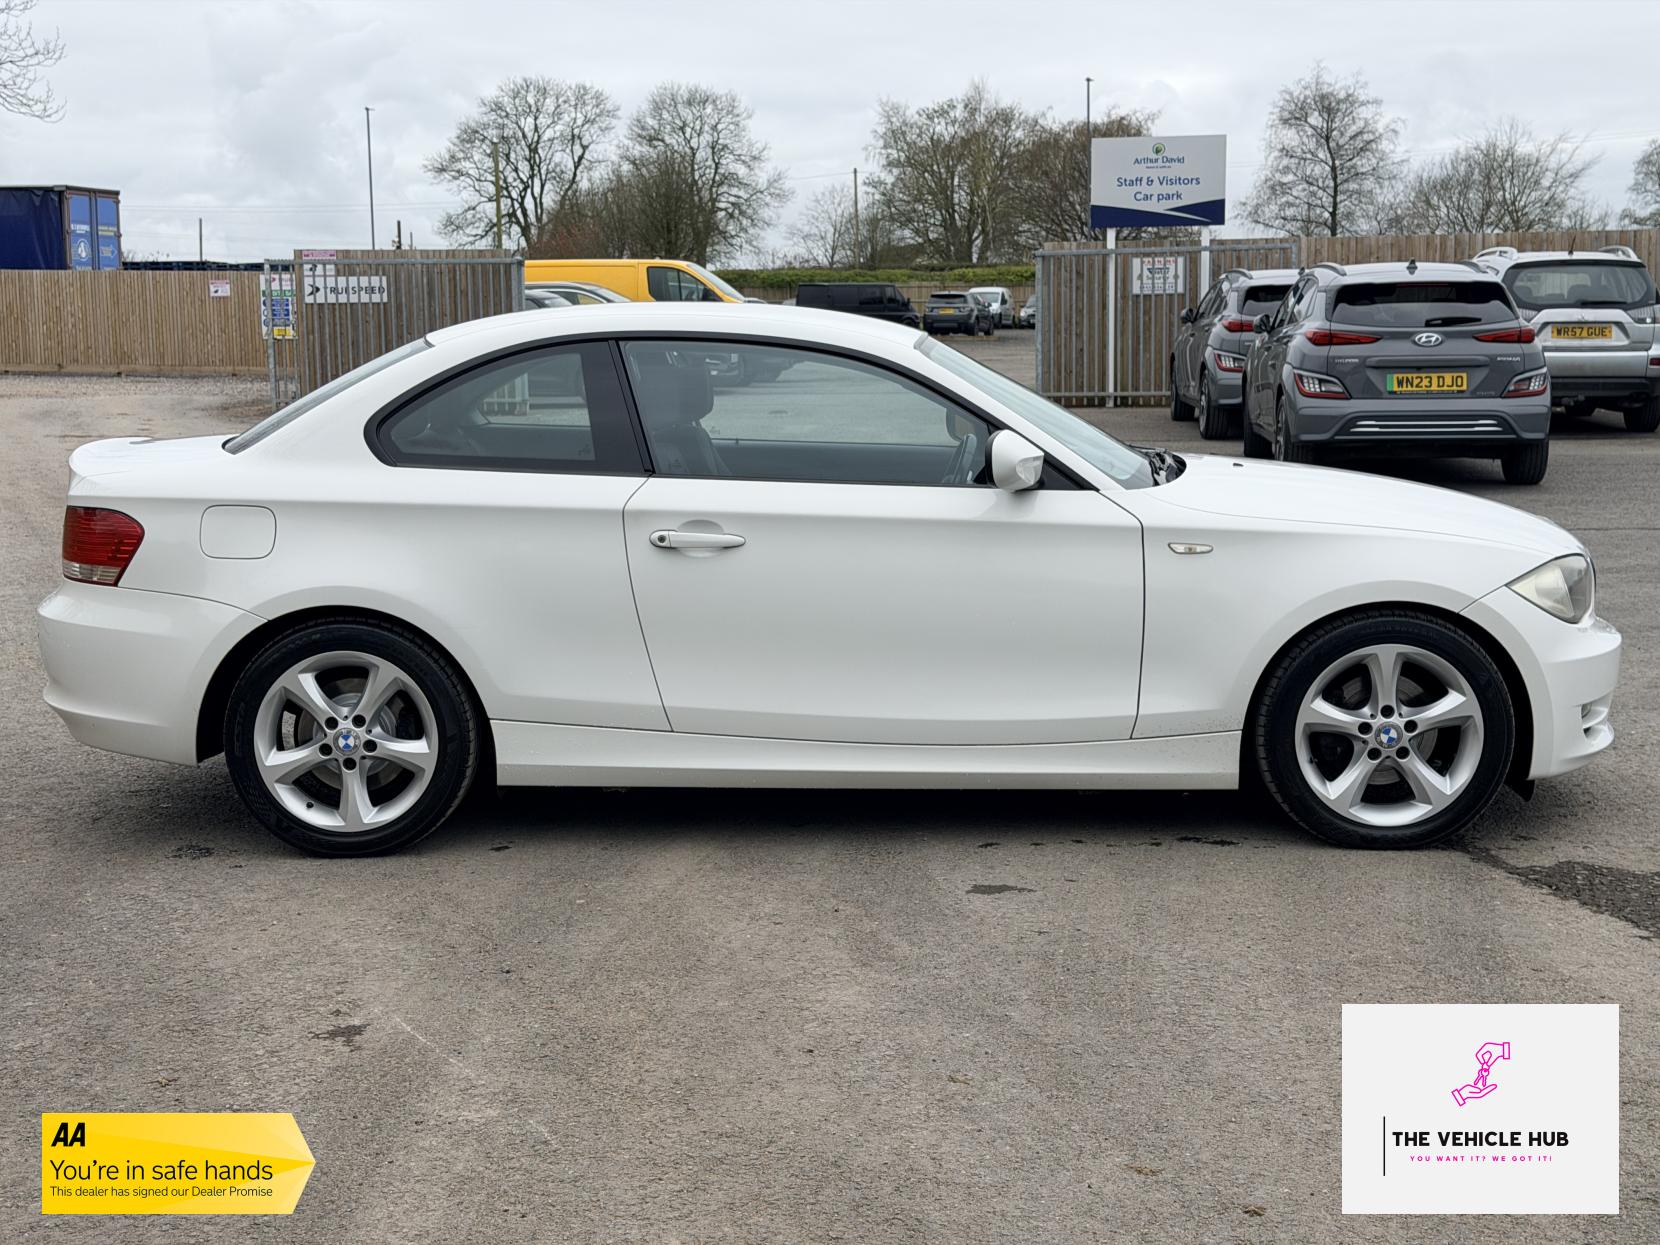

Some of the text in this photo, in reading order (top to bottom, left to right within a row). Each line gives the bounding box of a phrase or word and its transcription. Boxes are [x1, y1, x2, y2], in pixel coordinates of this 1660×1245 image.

[1133, 155, 1185, 165] Arthur David
[1116, 175, 1201, 188] Staff & Visitors
[1133, 191, 1183, 203] Car park
[1586, 326, 1608, 337] GUE
[1396, 375, 1464, 389] WN23 DJO
